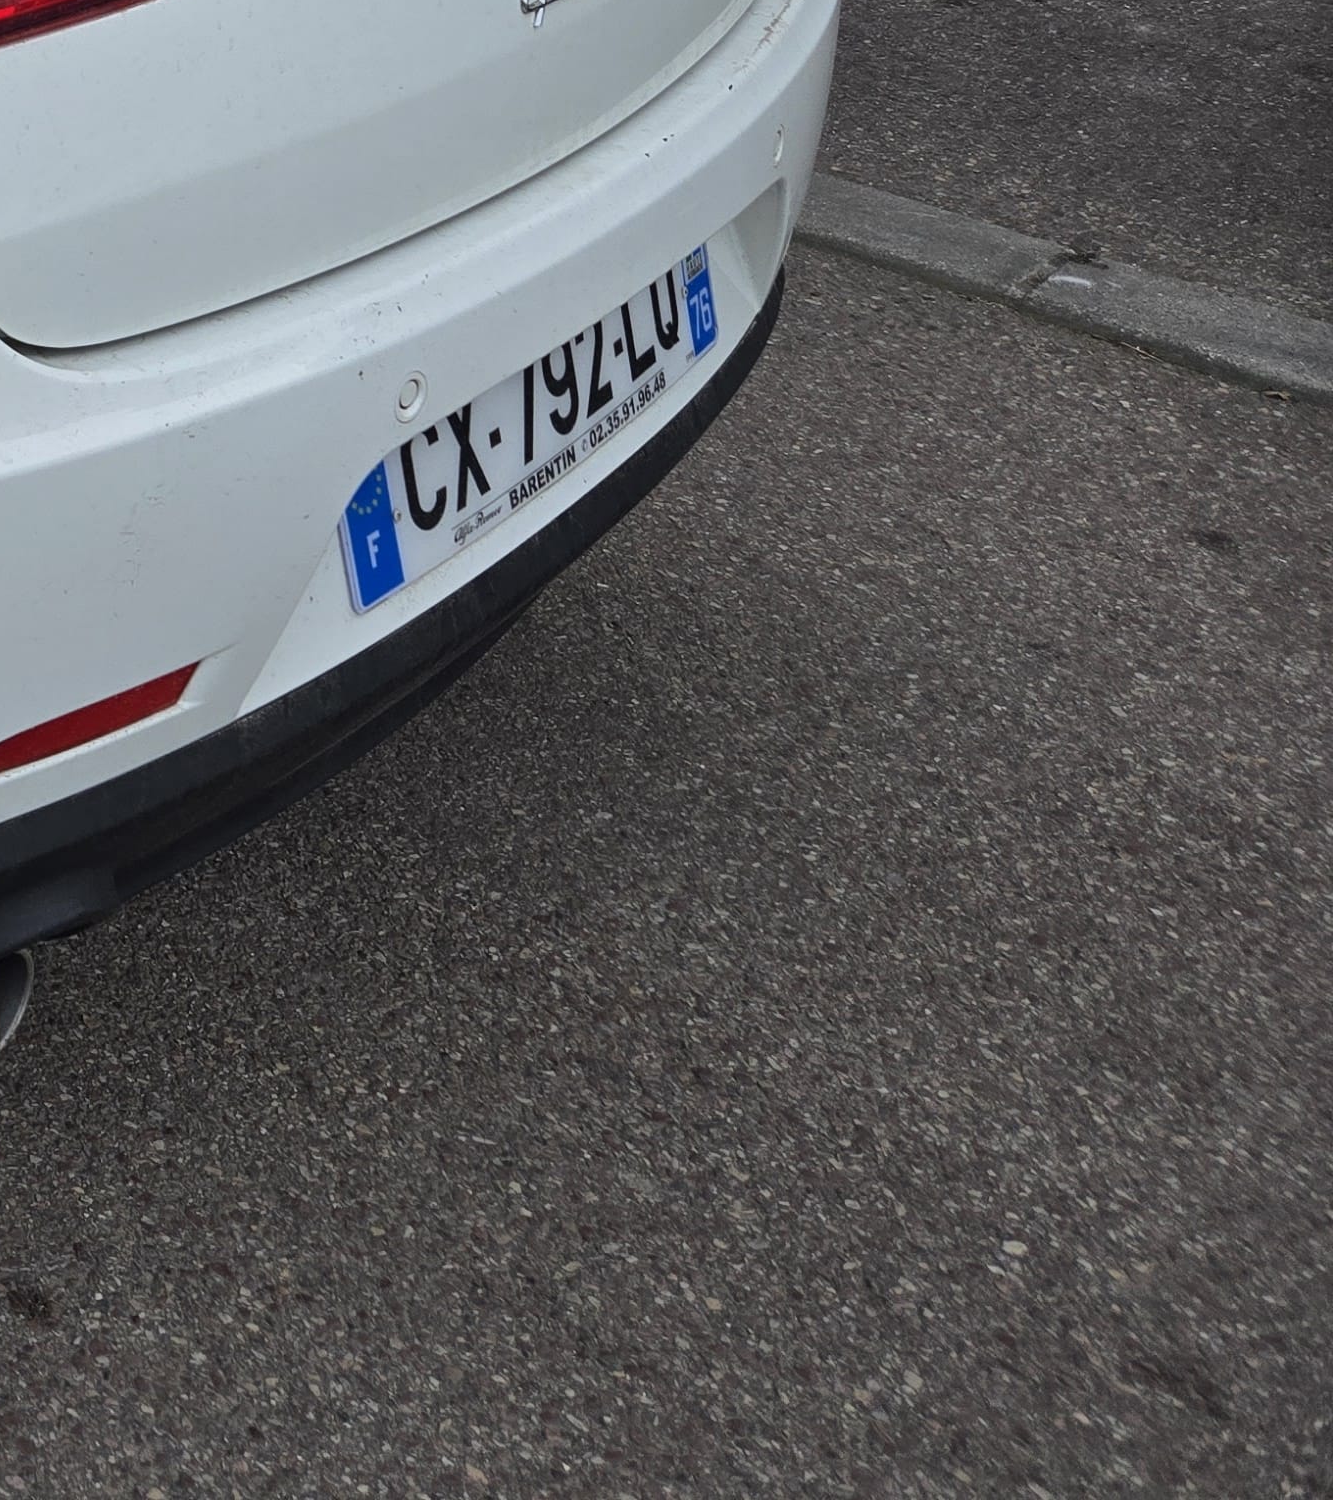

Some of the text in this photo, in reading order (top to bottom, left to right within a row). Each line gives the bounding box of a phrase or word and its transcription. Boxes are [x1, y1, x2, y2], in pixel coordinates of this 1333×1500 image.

[689, 286, 713, 340] 76
[509, 445, 577, 510] BARENTIN
[588, 371, 667, 448] 02.35.91.96.48
[366, 529, 381, 569] F
